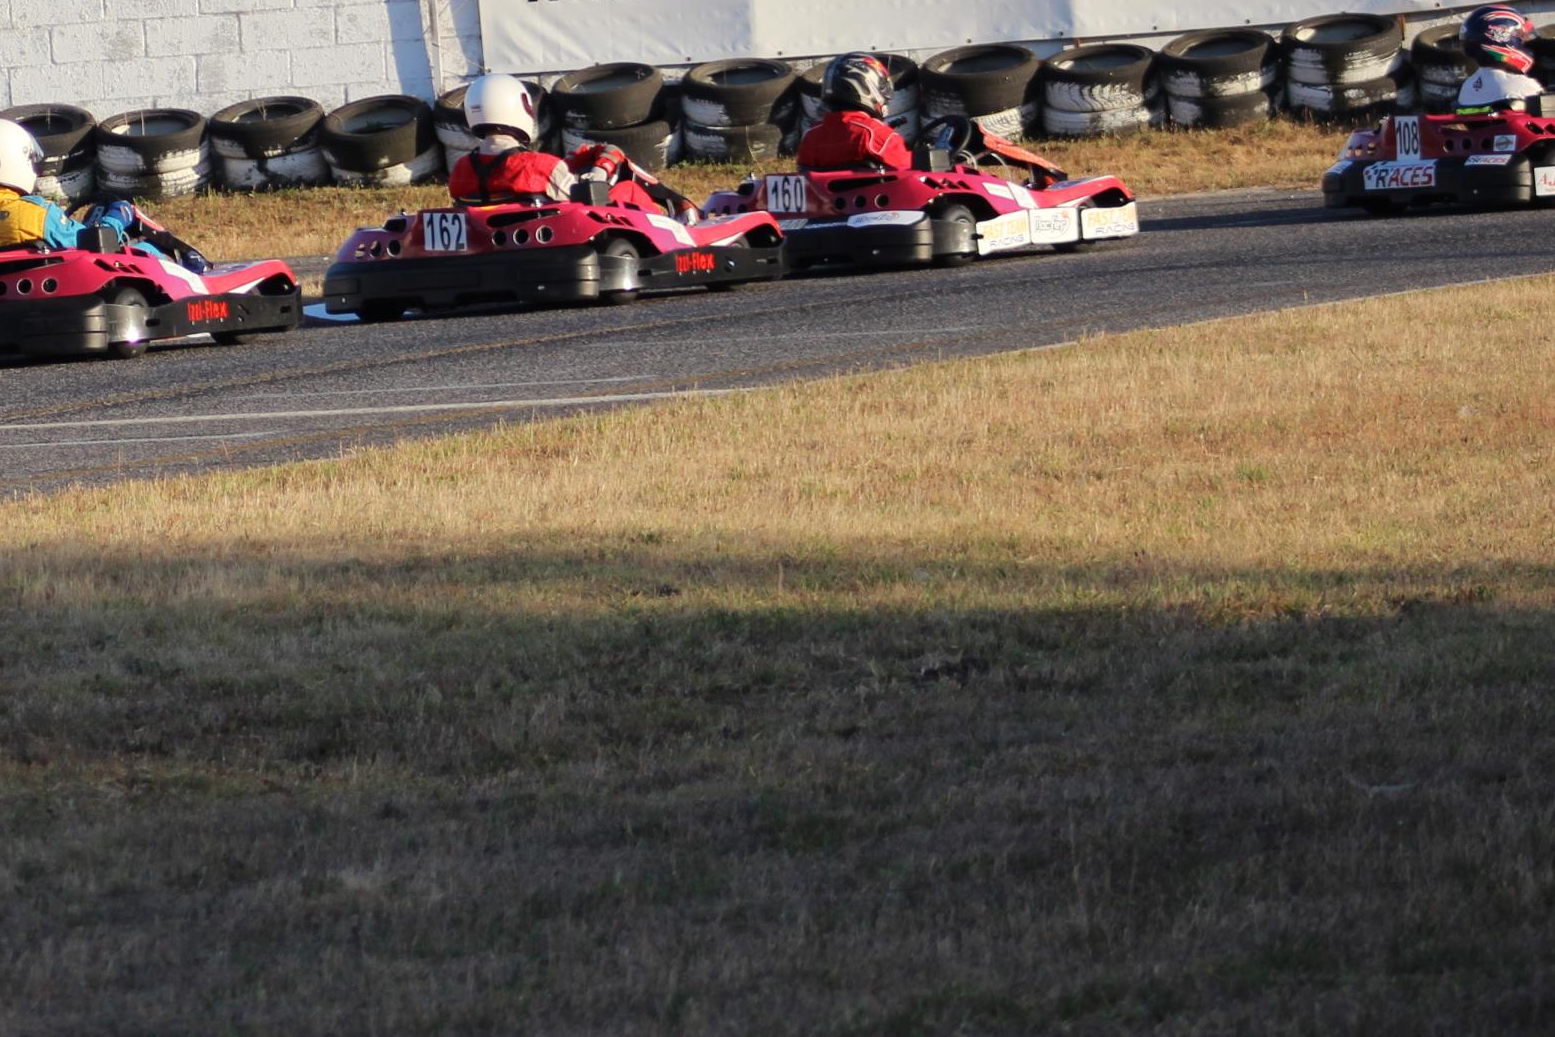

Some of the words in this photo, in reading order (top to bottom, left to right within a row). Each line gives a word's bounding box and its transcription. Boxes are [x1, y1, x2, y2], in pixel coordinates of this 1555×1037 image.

[1396, 120, 1419, 156] 108
[771, 176, 803, 212] 160
[427, 213, 465, 250] 162
